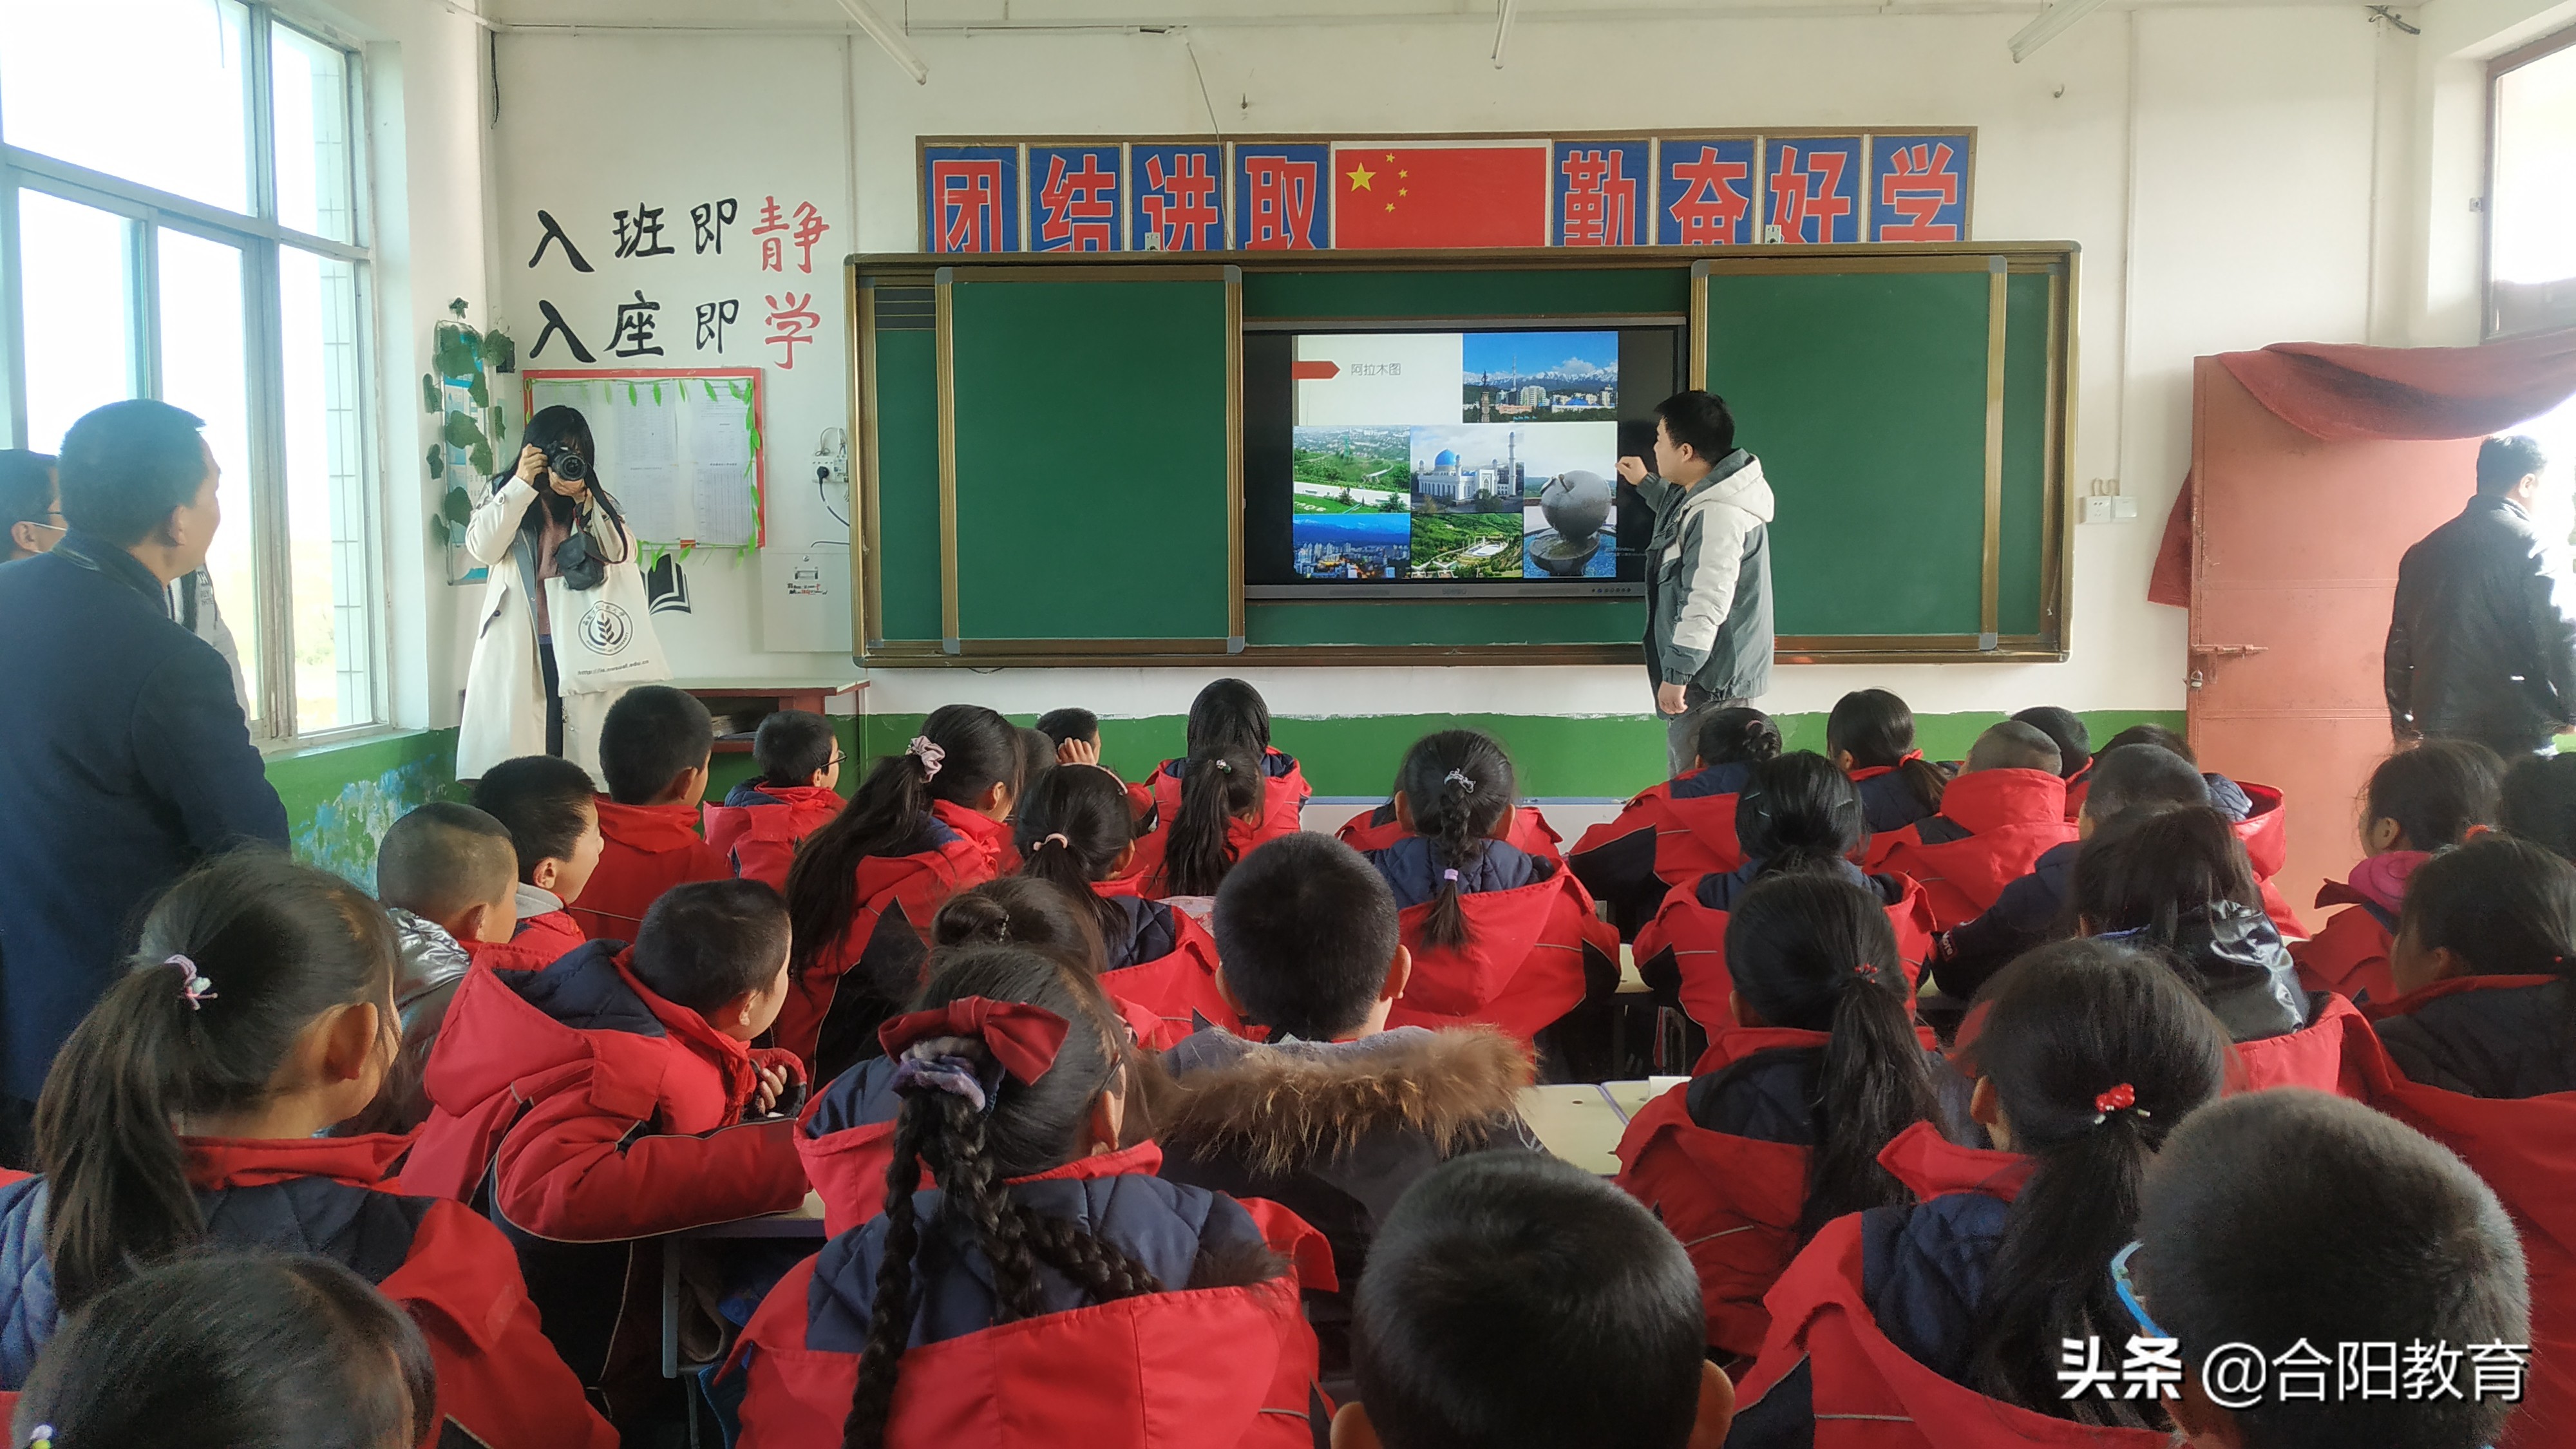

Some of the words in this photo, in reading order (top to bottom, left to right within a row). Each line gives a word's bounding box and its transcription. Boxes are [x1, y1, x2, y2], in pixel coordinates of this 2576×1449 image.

[528, 195, 829, 274] 入班即静
[1561, 143, 1957, 246] 勤奋好学
[529, 289, 820, 370] 入座即学
[1351, 363, 1401, 375] 阿拉木图
